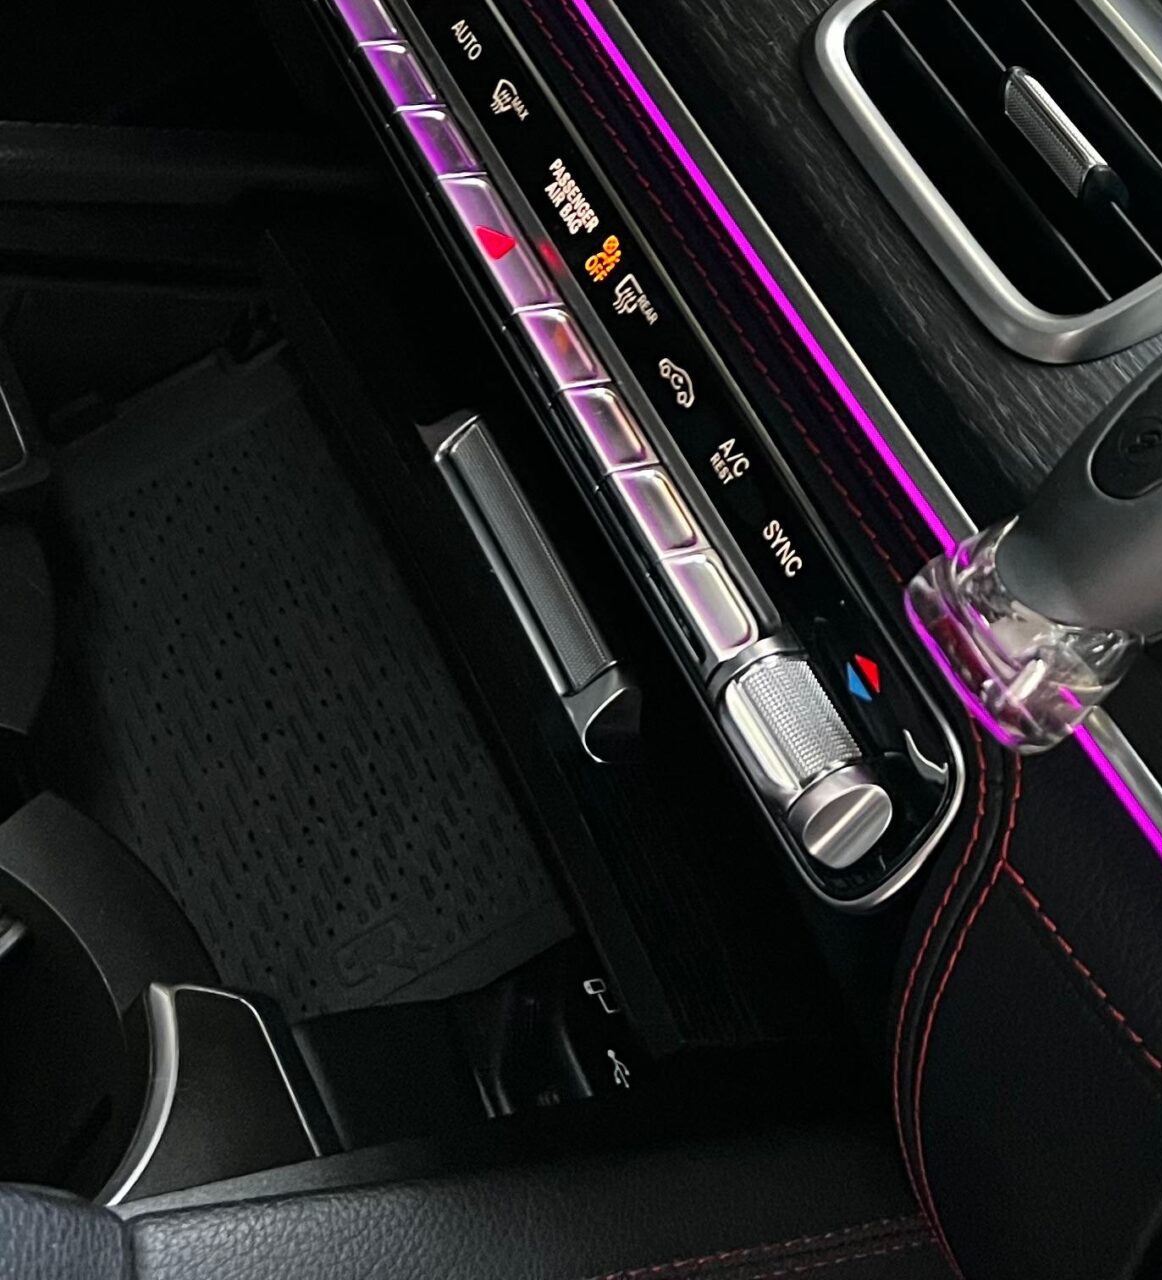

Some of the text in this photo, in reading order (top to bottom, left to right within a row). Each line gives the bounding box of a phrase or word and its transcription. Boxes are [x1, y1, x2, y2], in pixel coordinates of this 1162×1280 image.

[450, 19, 482, 61] AUTO
[511, 96, 530, 121] MAX
[544, 181, 583, 235] AIR BAG
[548, 157, 599, 234] PASSENGER
[585, 255, 607, 282] OFF
[709, 451, 734, 485] REST
[718, 437, 750, 478] A/C
[762, 519, 803, 578] SYNC
